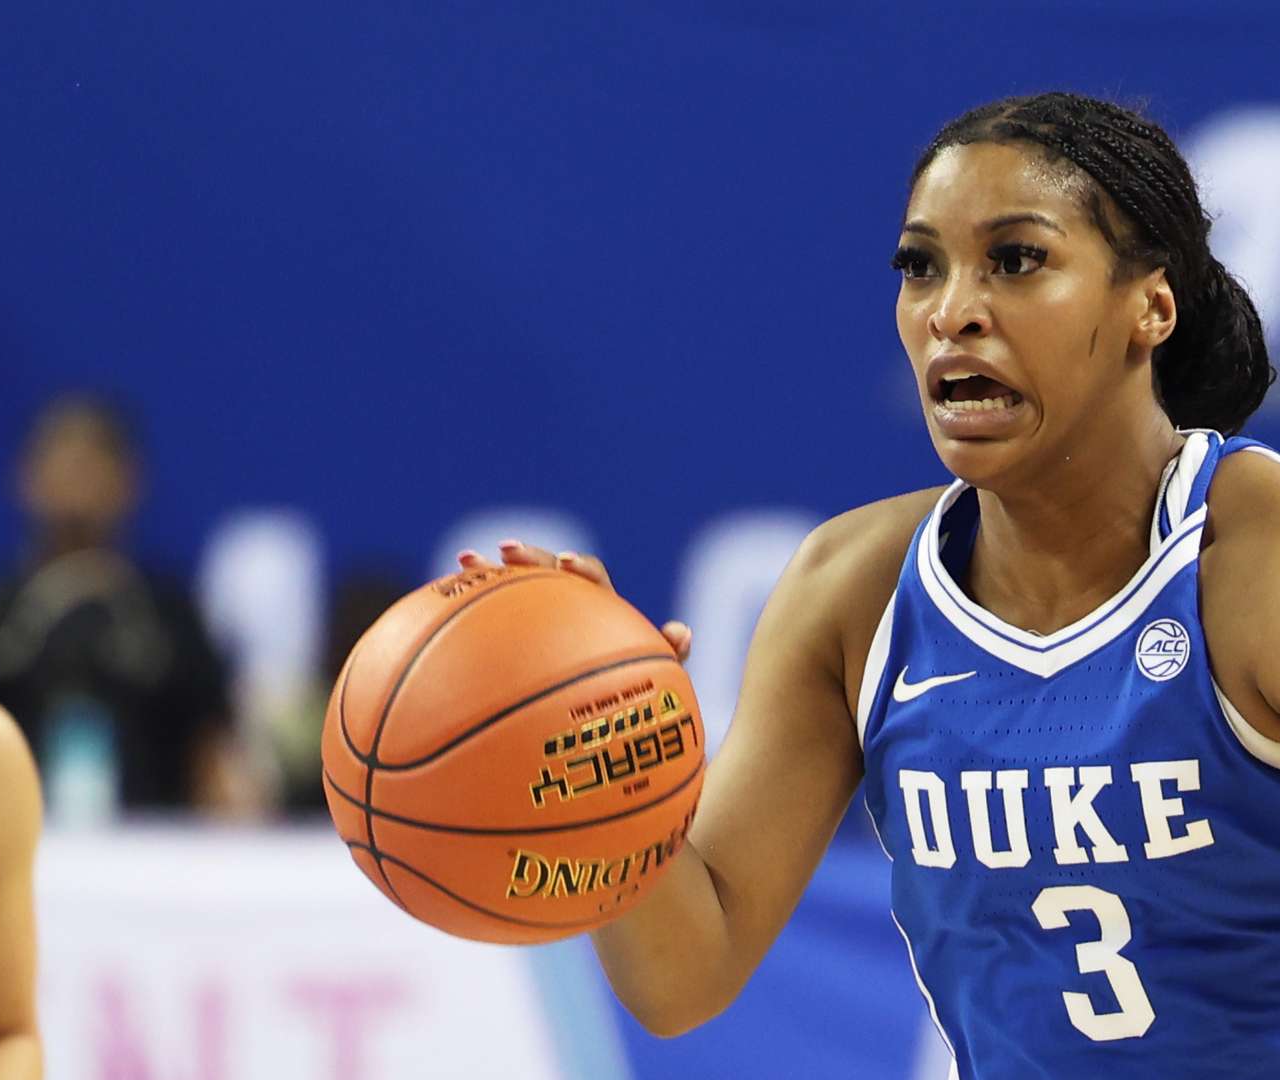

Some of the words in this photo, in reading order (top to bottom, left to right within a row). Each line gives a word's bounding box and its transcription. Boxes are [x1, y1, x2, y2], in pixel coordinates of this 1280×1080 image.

[1145, 639, 1186, 653] ACC
[529, 712, 698, 809] LEGACY
[898, 759, 1215, 869] DUKE
[1031, 885, 1156, 1042] 3
